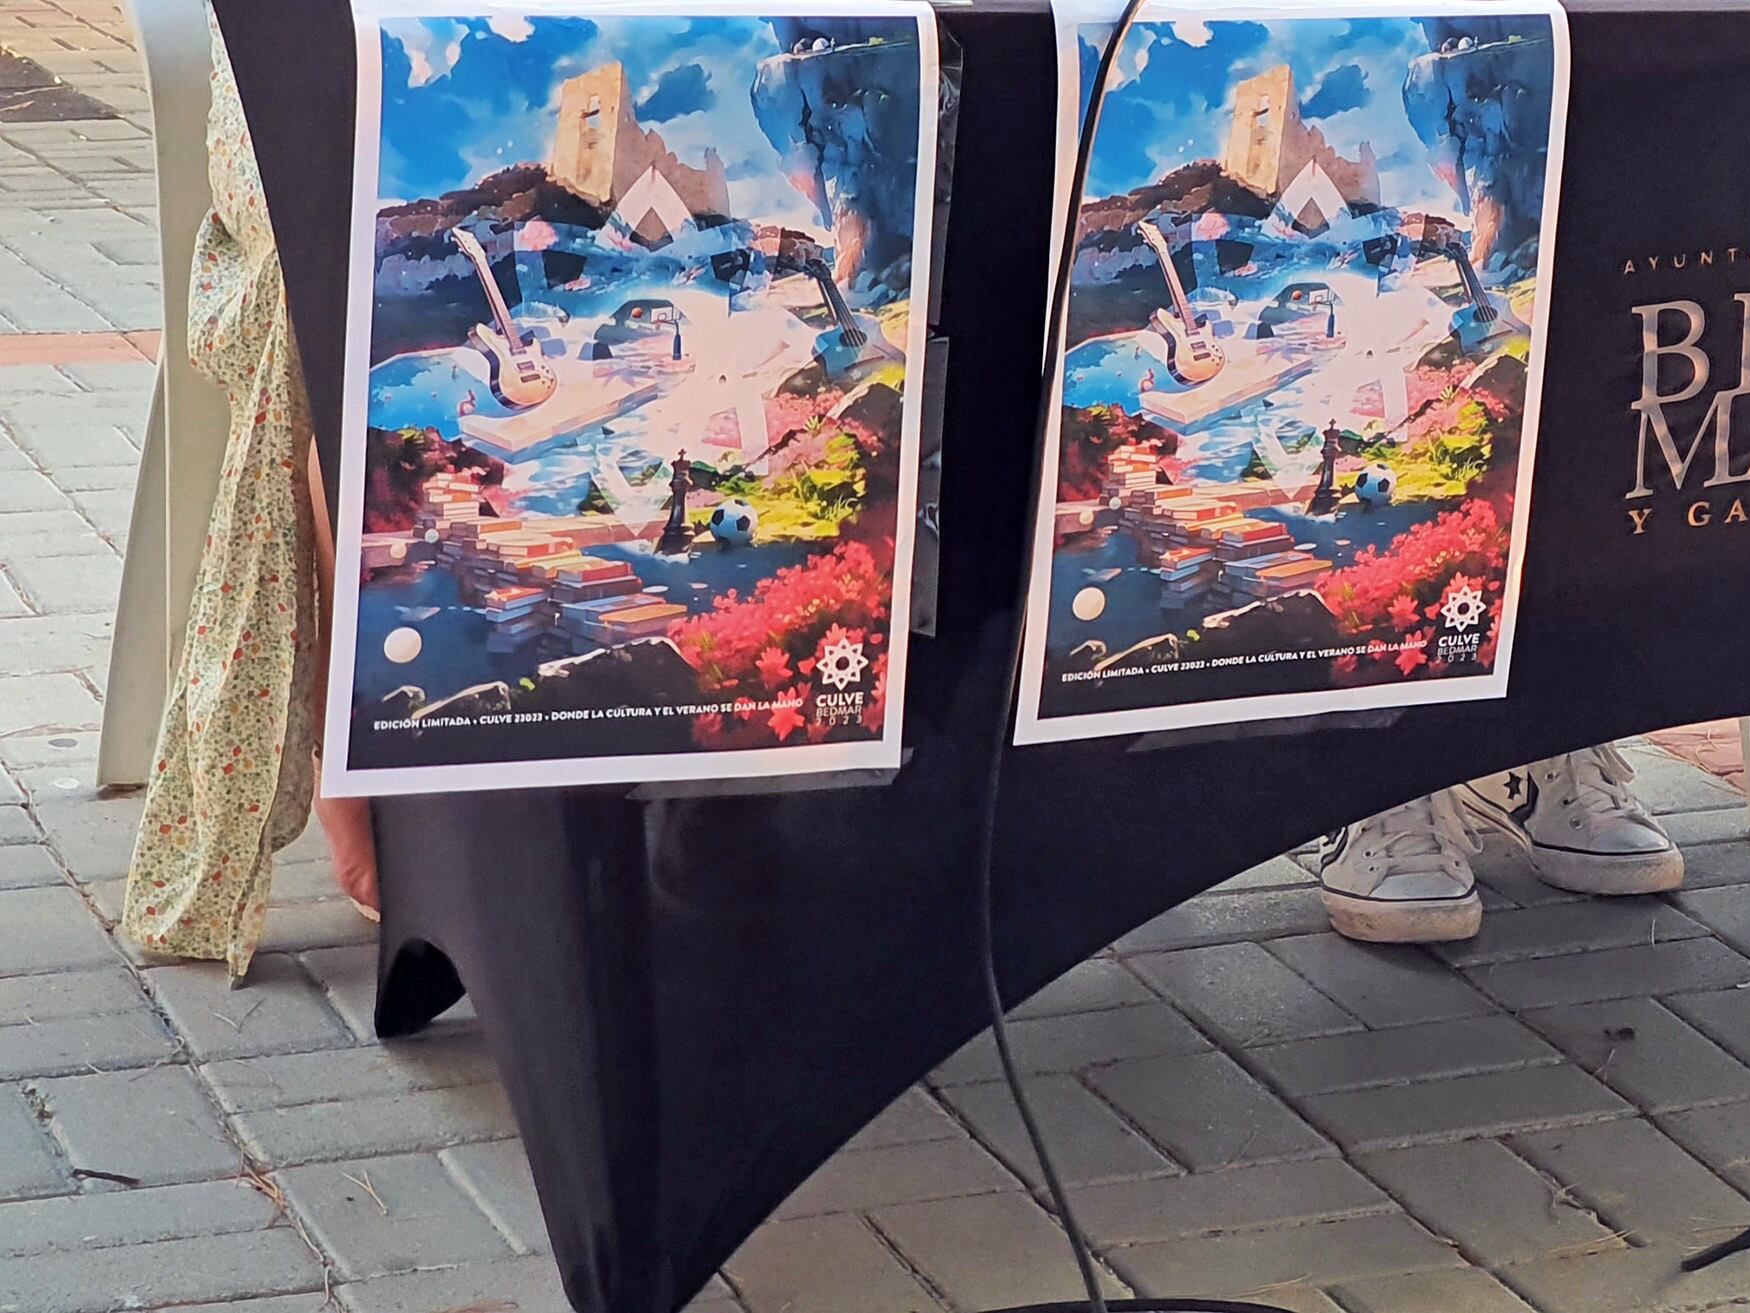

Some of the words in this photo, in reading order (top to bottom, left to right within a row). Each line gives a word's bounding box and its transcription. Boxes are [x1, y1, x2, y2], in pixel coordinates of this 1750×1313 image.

[1628, 508, 1651, 535] Y
[1438, 632, 1481, 647] CULVE
[1437, 644, 1478, 656] BEDMAR
[1062, 669, 1101, 682] EDICIÓN
[1102, 667, 1144, 678] LIMITADA
[1151, 663, 1179, 673] CULVE
[1180, 660, 1205, 671] 23023
[1211, 656, 1244, 667] DONDE
[1245, 655, 1257, 664] LA
[1257, 652, 1299, 663] CULTURA
[1299, 651, 1306, 659] Y
[1306, 650, 1317, 659] EL
[1318, 646, 1355, 658] VERANO
[1356, 645, 1366, 654] SE
[1367, 643, 1387, 653] DAN
[1388, 642, 1399, 651] LA
[816, 691, 864, 707] CULVE
[374, 718, 420, 730] EDICIÓN
[422, 716, 470, 728] LIMITADA
[479, 714, 512, 725] CULVE
[513, 713, 543, 724] 23023
[551, 710, 589, 721] DONDE
[591, 709, 604, 719] LA
[606, 707, 652, 718] CULTURA
[654, 707, 661, 716] Y
[662, 706, 675, 716] EL
[675, 703, 719, 715] VERANO
[721, 703, 732, 713] SE
[734, 701, 756, 712] DAN
[758, 700, 771, 711] LA
[772, 698, 803, 709] MANO
[816, 705, 862, 718] BEDMAR
